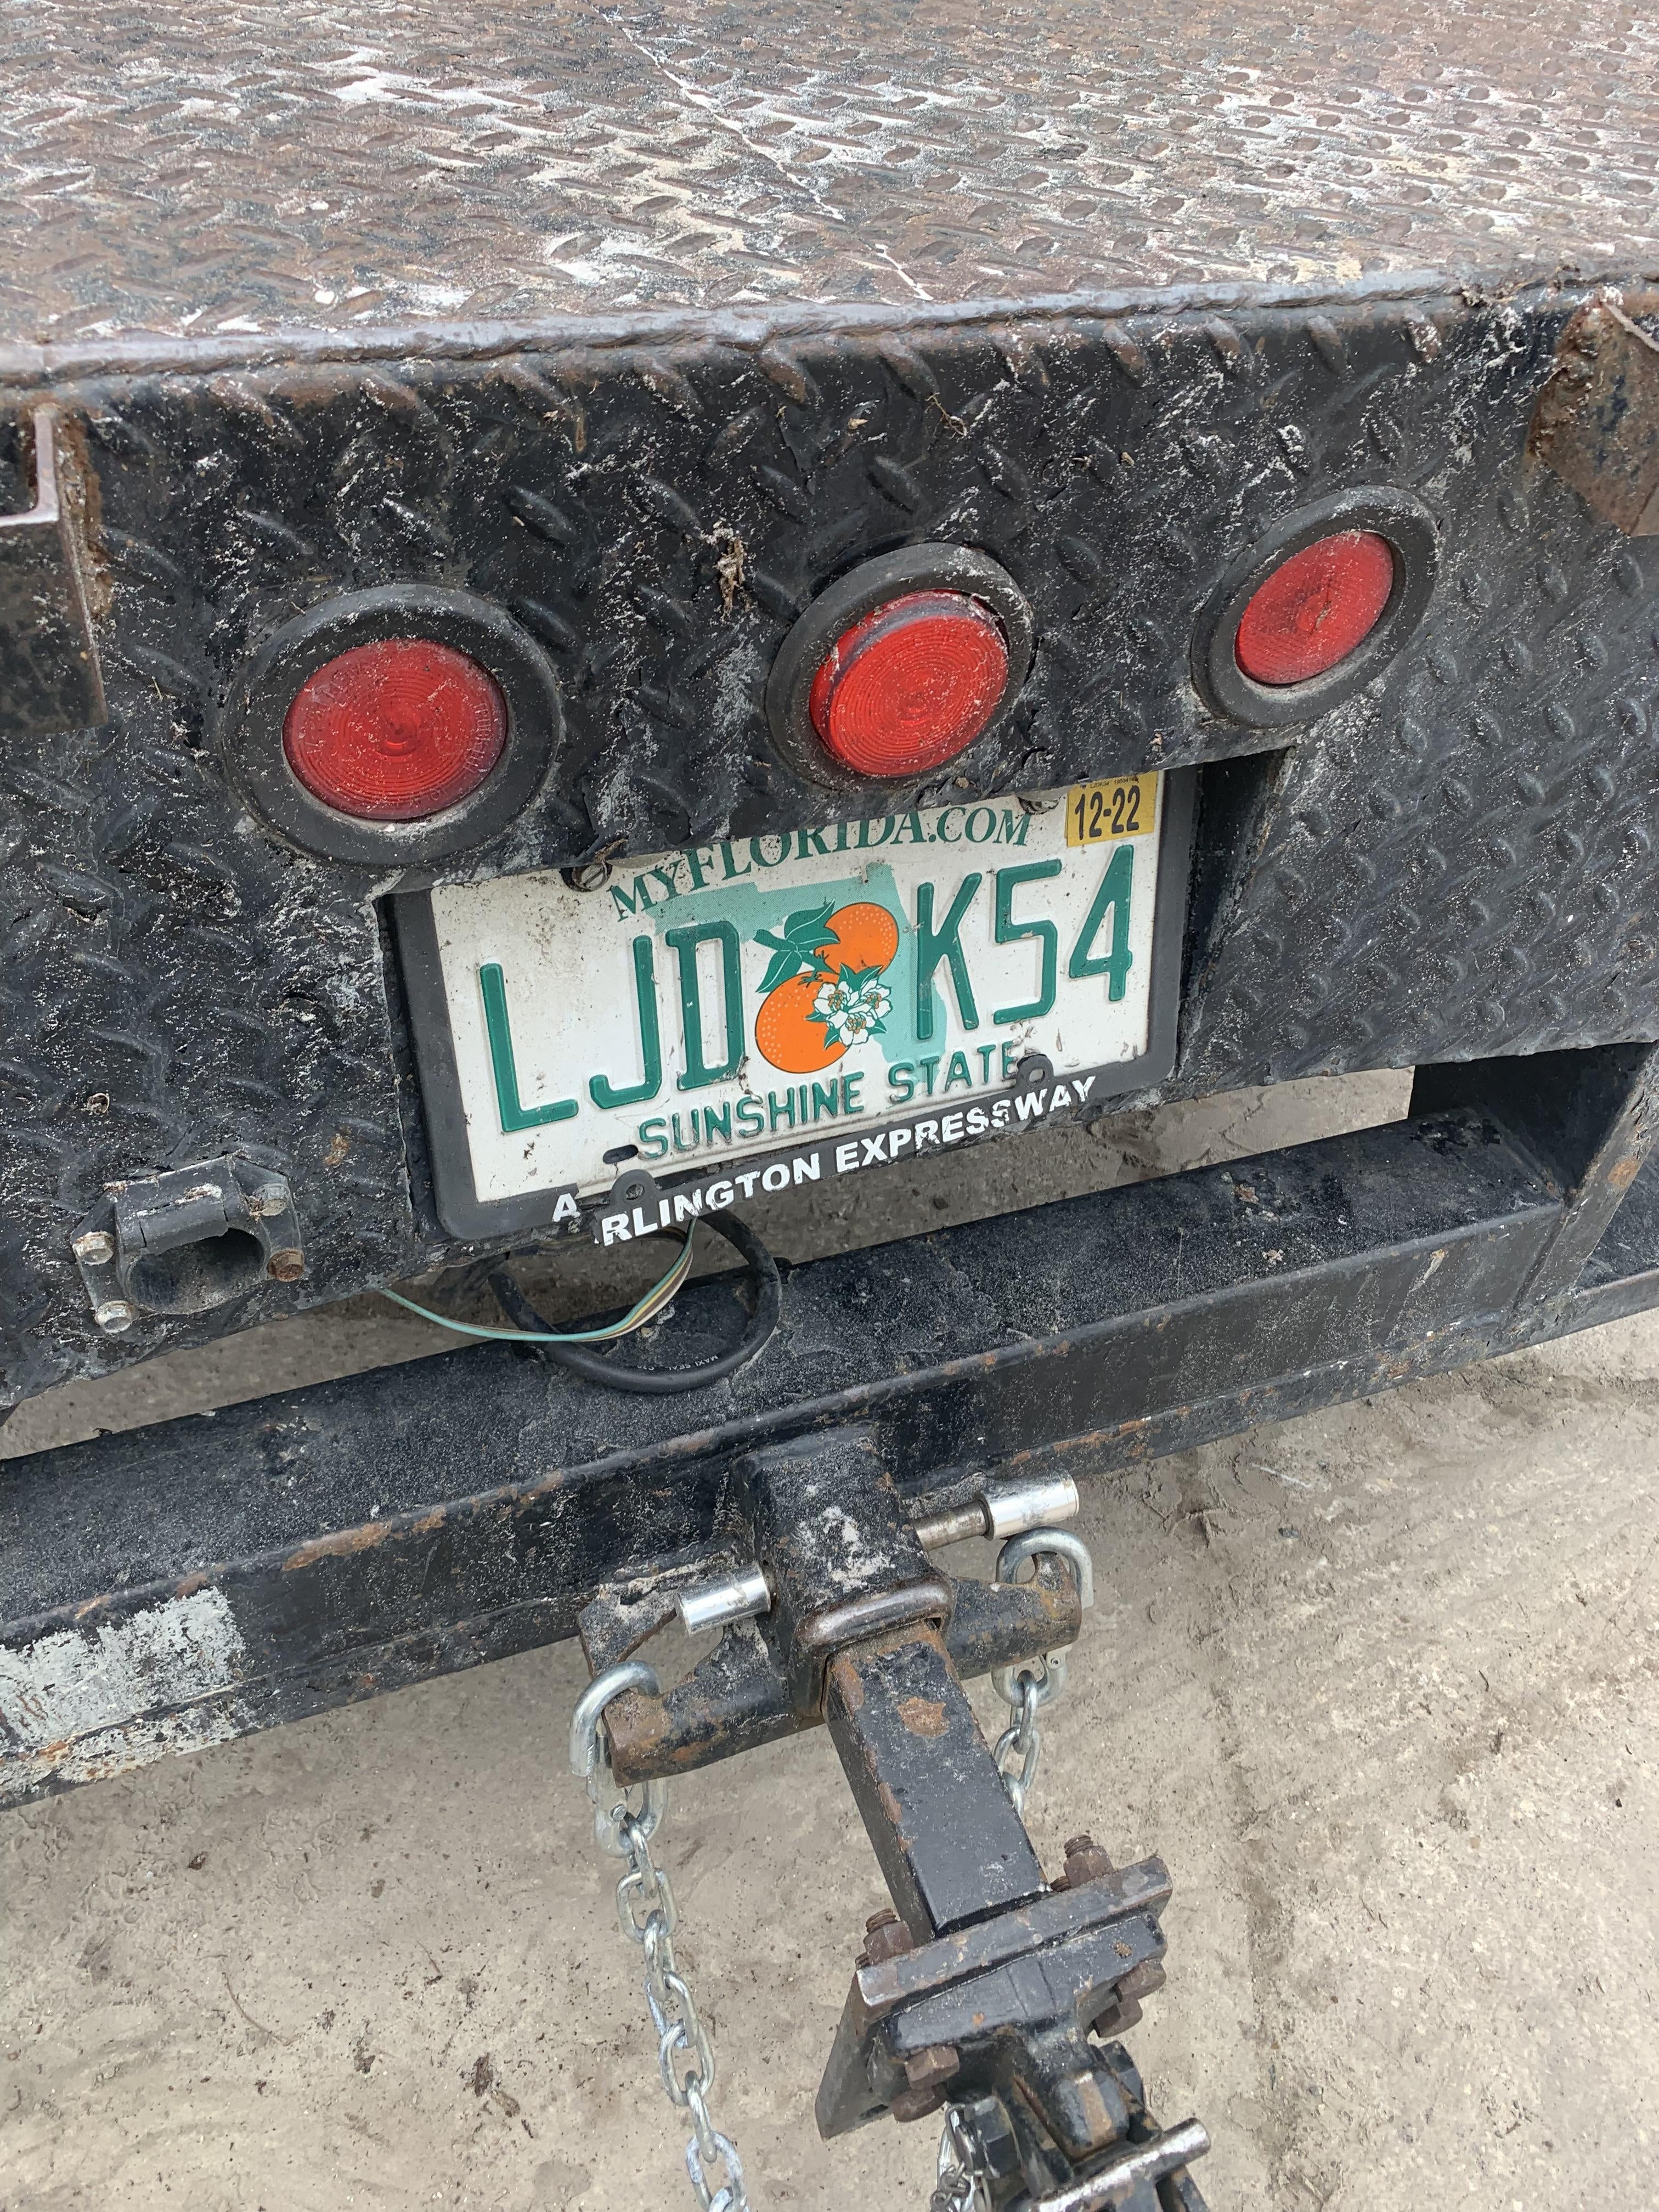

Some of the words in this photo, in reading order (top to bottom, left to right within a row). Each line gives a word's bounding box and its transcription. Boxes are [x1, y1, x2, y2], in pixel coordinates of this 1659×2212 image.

[606, 806, 1032, 922] MYFLORIDA.COM
[1075, 785, 1141, 840] 12-22
[639, 1071, 865, 1159] SUNSHINE
[889, 1040, 1018, 1103] STATE
[836, 1075, 1096, 1173] EXPRESSWAY
